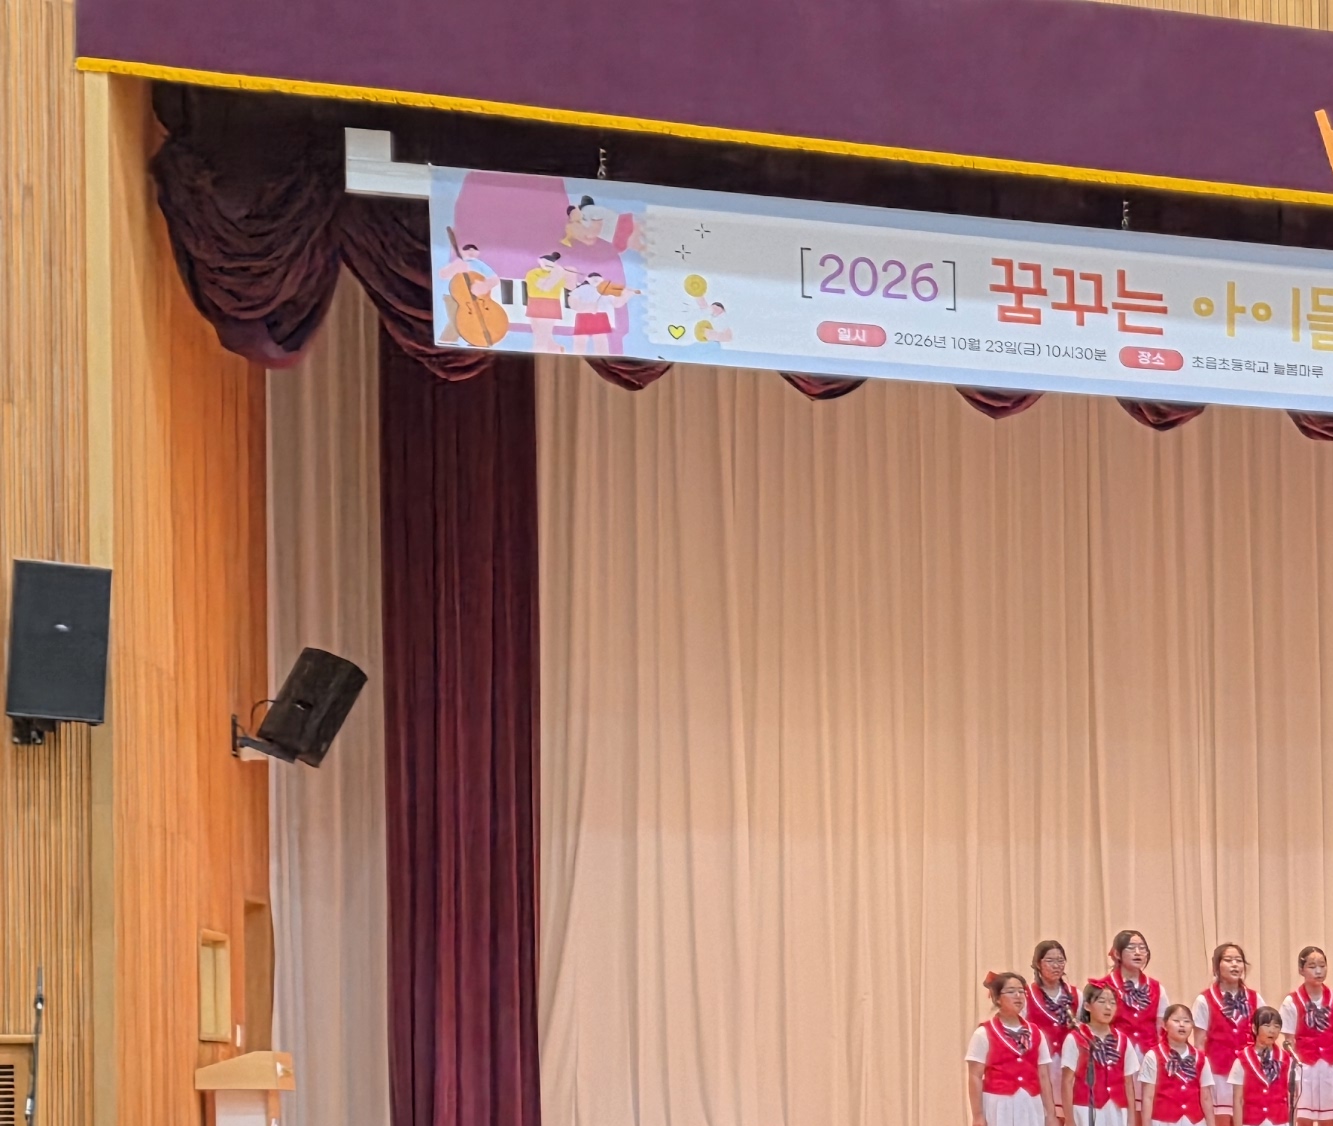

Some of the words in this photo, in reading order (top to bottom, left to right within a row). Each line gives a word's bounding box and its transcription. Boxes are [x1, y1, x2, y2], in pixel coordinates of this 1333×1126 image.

[800, 247, 956, 311] [2026]
[989, 257, 1168, 336] 꿈꾸는
[836, 326, 867, 343] 일시
[894, 332, 947, 350] 2026년
[952, 336, 981, 352] 10월
[985, 339, 1041, 358] 23일(금)
[1045, 344, 1107, 362] 10시30분
[1137, 350, 1166, 367] 장소
[1192, 355, 1269, 375] 초읍초등학교
[1273, 363, 1324, 379] 늘봄마루
